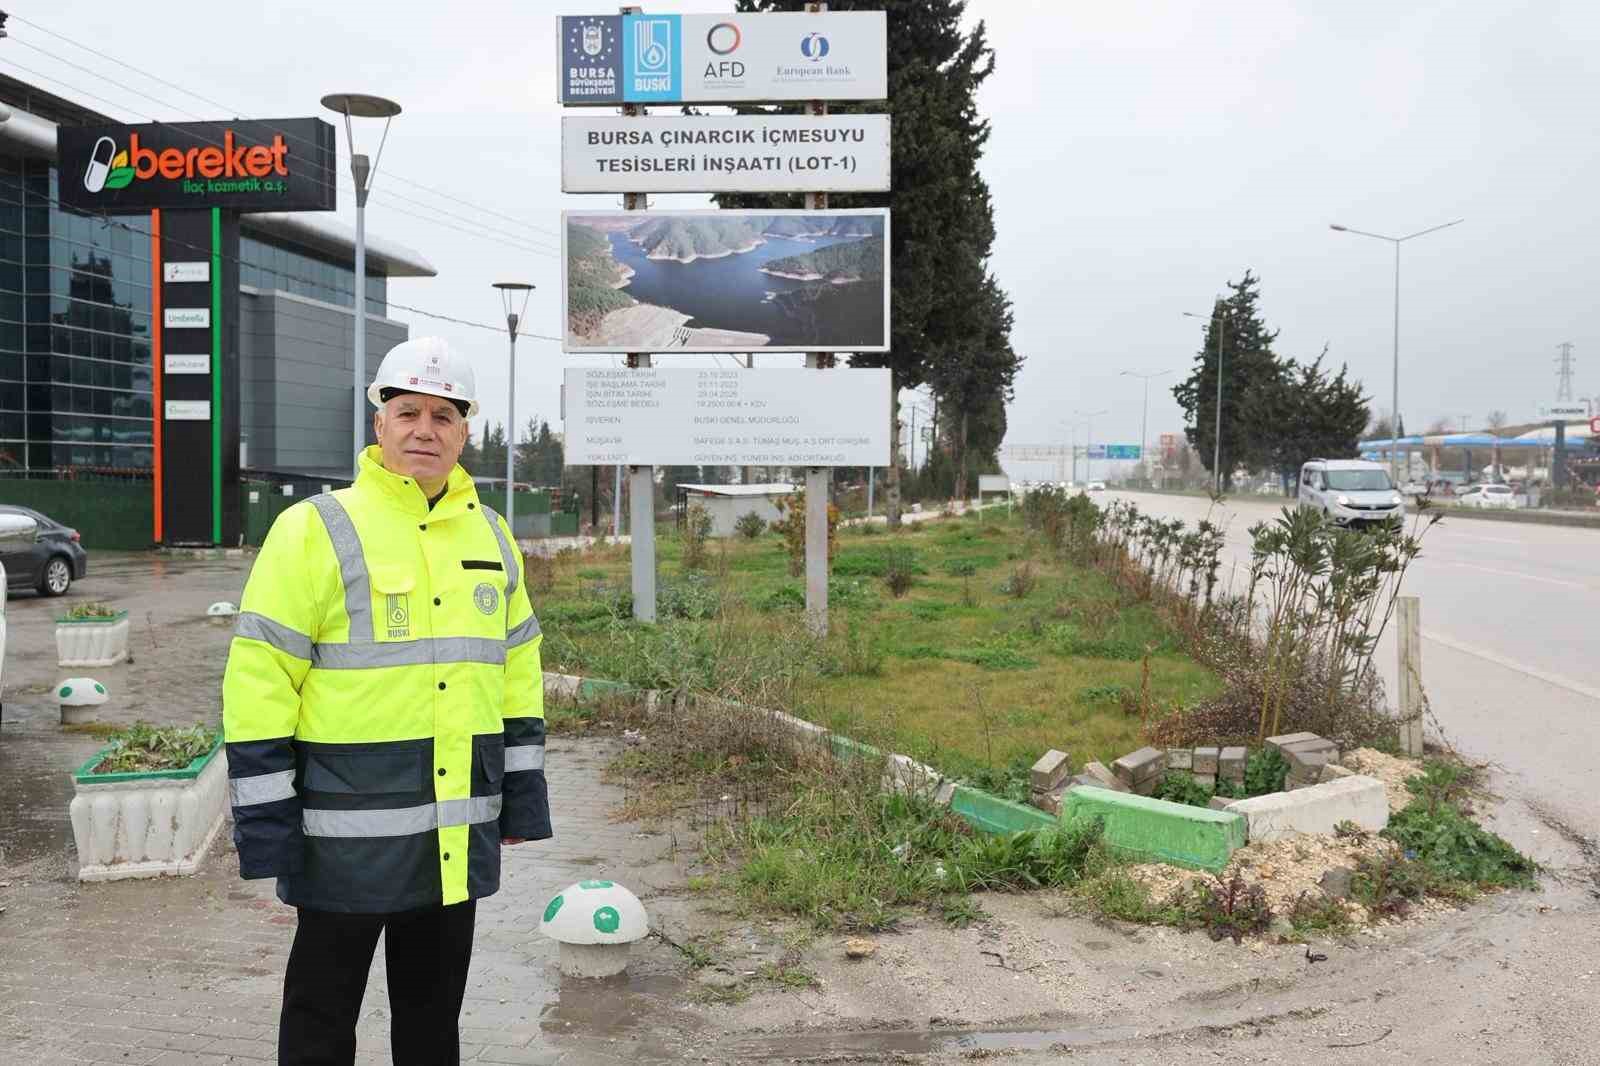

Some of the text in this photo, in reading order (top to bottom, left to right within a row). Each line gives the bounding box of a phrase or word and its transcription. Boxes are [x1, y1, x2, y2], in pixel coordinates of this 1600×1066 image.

[570, 67, 616, 78] BURSA
[704, 61, 745, 78] AFD
[776, 64, 851, 77] European Bank
[570, 86, 616, 95] BELEDİYESİ
[633, 76, 672, 92] BUSKİ
[587, 126, 866, 148] BURSA ÇINARCIK İÇMESUYU
[131, 128, 289, 180] bereket
[596, 153, 857, 175] TESİSLERİ İNŞAATI (LOT-1)
[183, 180, 205, 197] ilaç
[207, 178, 261, 194] kozmetik
